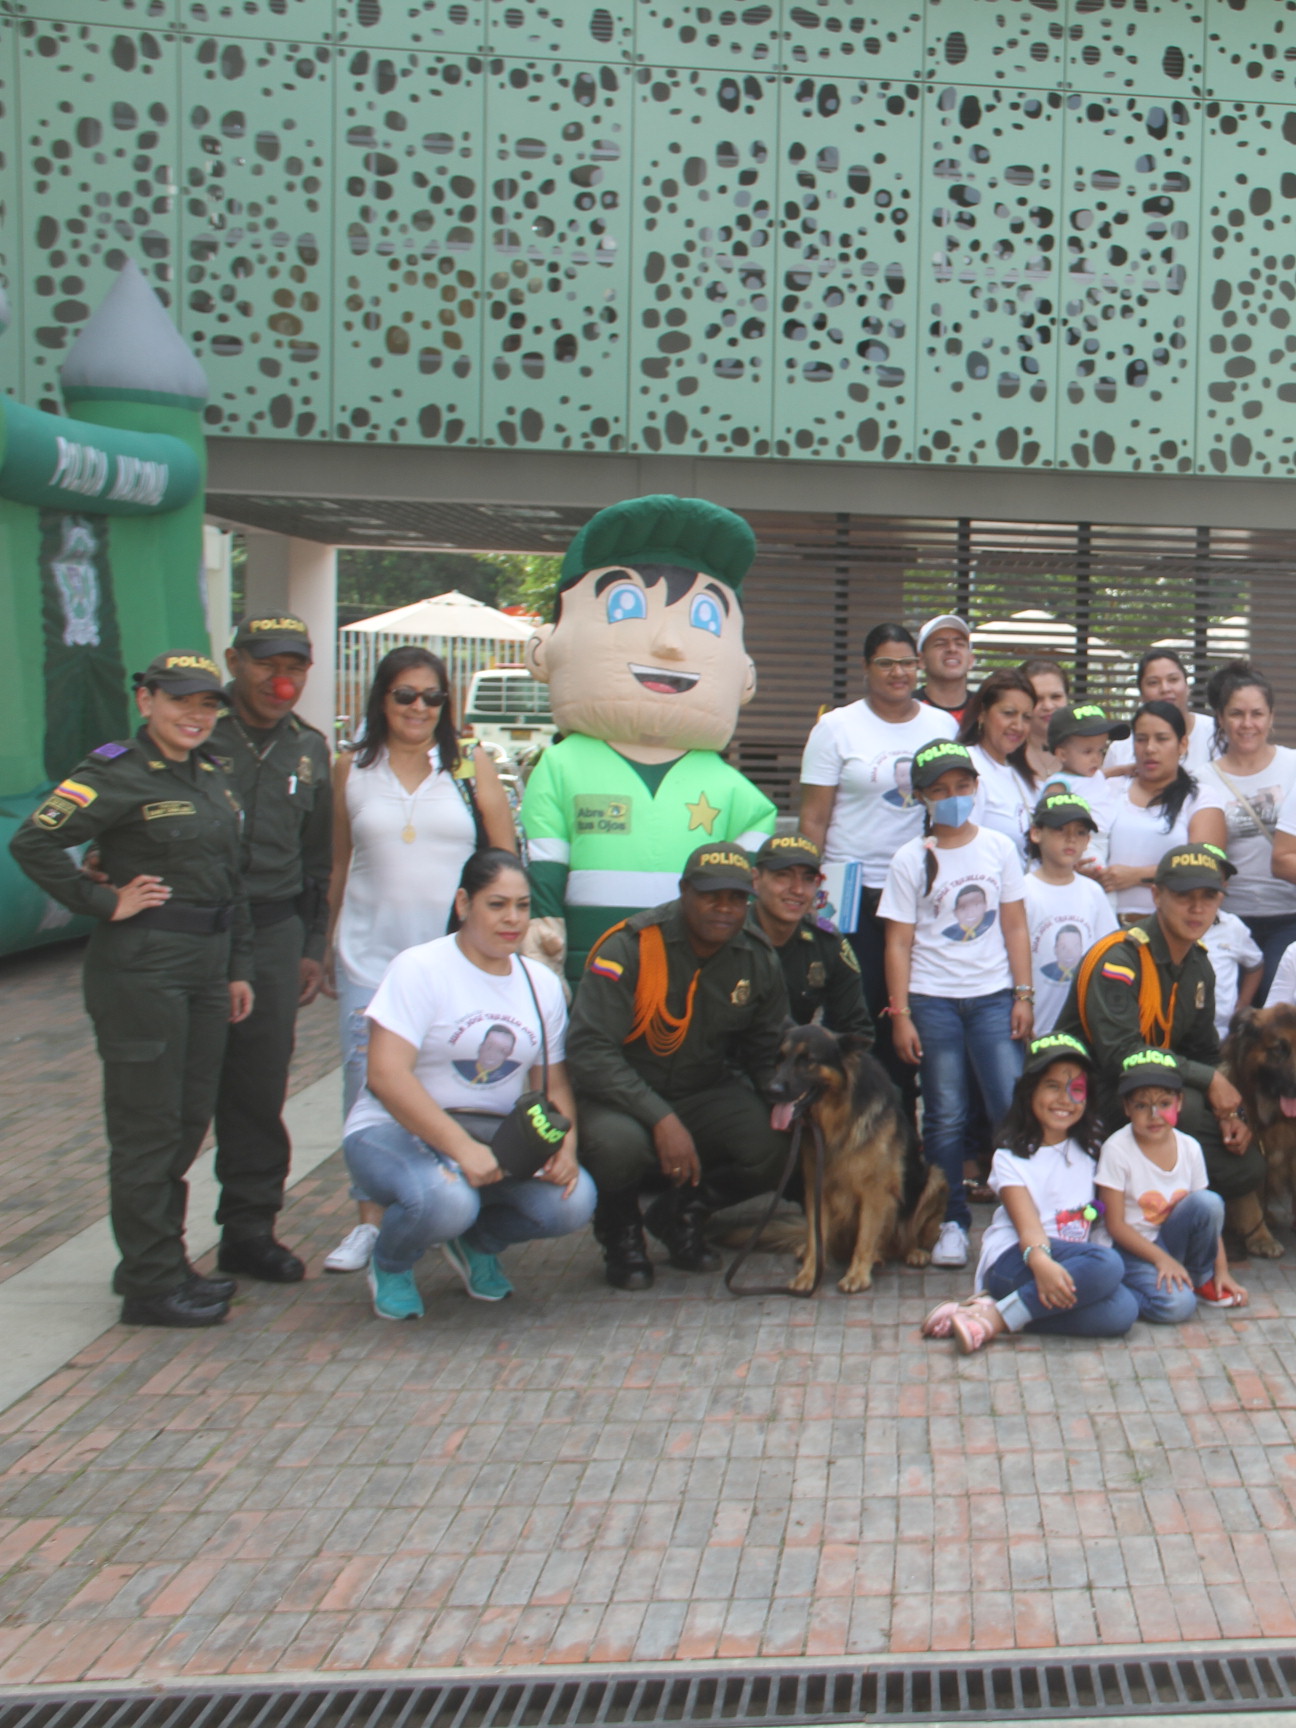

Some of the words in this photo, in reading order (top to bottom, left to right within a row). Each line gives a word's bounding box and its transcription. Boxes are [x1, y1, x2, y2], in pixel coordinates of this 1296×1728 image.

[916, 743, 970, 767] POLICIA
[771, 837, 820, 857] POLICIA
[700, 852, 751, 871] POLICIA
[1171, 853, 1218, 871] POLICIA
[1031, 1033, 1088, 1056] POLICIA
[1122, 1050, 1177, 1072] POLICIA
